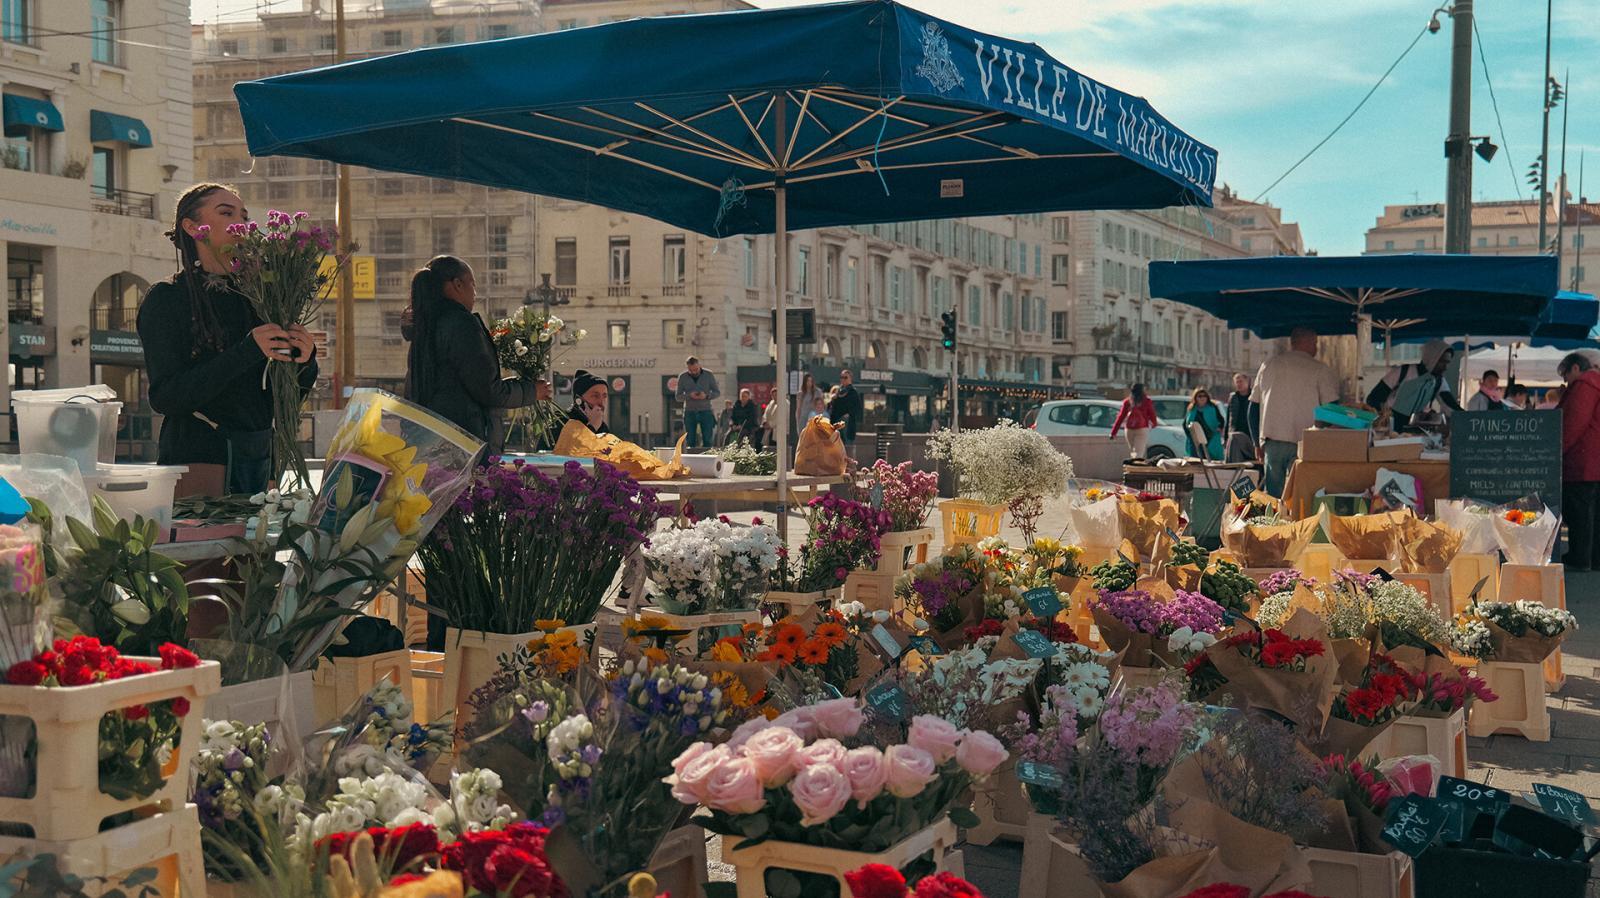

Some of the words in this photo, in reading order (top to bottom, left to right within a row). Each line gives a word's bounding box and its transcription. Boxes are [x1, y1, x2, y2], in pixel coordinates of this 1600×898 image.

[975, 38, 1068, 123] VILLE
[1075, 75, 1108, 139] DE
[19, 335, 46, 345] STAN
[107, 337, 139, 345] PROVENCE
[583, 357, 625, 368] BURGER
[1469, 418, 1511, 432] PAINS
[1452, 784, 1481, 800] 20
[1484, 789, 1496, 798] €
